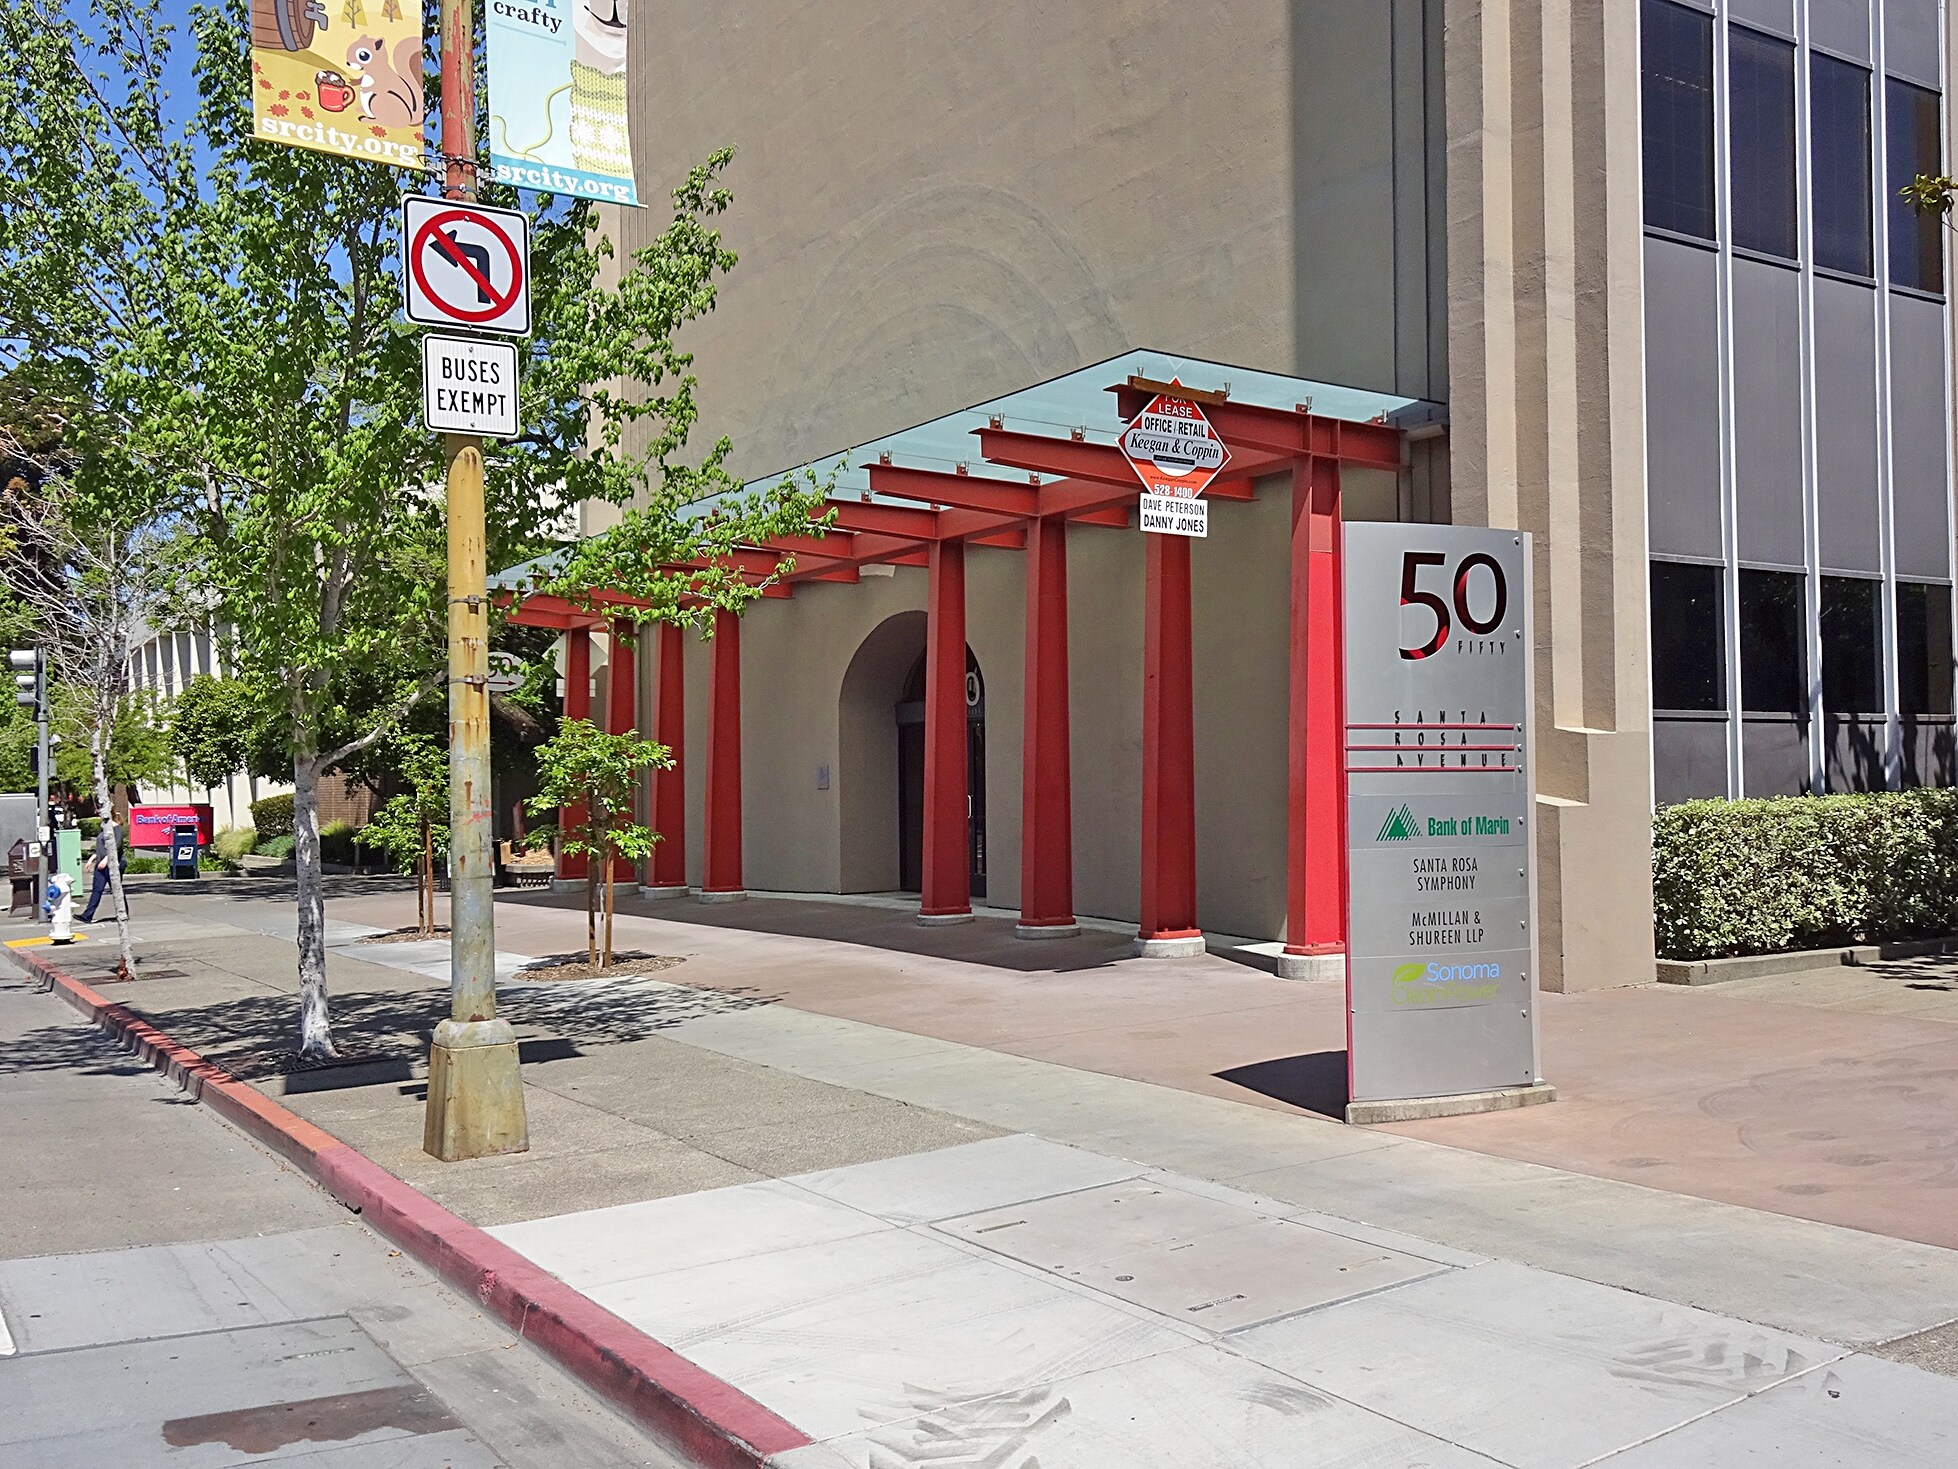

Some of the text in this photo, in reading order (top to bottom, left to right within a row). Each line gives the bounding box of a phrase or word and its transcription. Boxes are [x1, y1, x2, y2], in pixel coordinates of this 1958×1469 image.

[493, 1, 562, 34] crafty
[261, 117, 419, 166] srcity.org
[495, 163, 630, 202] srcity.org
[442, 356, 500, 384] BUSES
[437, 388, 506, 416] EXEMPT
[1158, 403, 1193, 418] LEASE
[1144, 416, 1172, 433] OFFICE
[1178, 421, 1206, 438] RETAIL
[1130, 433, 1219, 460] Keegan & Coppin
[1154, 483, 1193, 499] 528-1400
[1143, 498, 1205, 516] DAVE PETERSON
[1144, 514, 1204, 533] DANNY JONES
[1398, 551, 1508, 661] 50
[1457, 640, 1506, 655] FIFTY
[1394, 710, 1486, 724] SANTA
[1394, 732, 1467, 746] ROSA
[1396, 753, 1506, 767] AVENUE
[137, 814, 161, 824] Bank
[1428, 816, 1509, 836] Bank of Marin
[1413, 857, 1478, 873] SANTA ROSA
[1417, 875, 1475, 891] SYMPHONY
[1412, 911, 1481, 927] McMILLAN &
[1409, 928, 1484, 946] SHUREEN LLP
[1426, 961, 1500, 982] Sonoma
